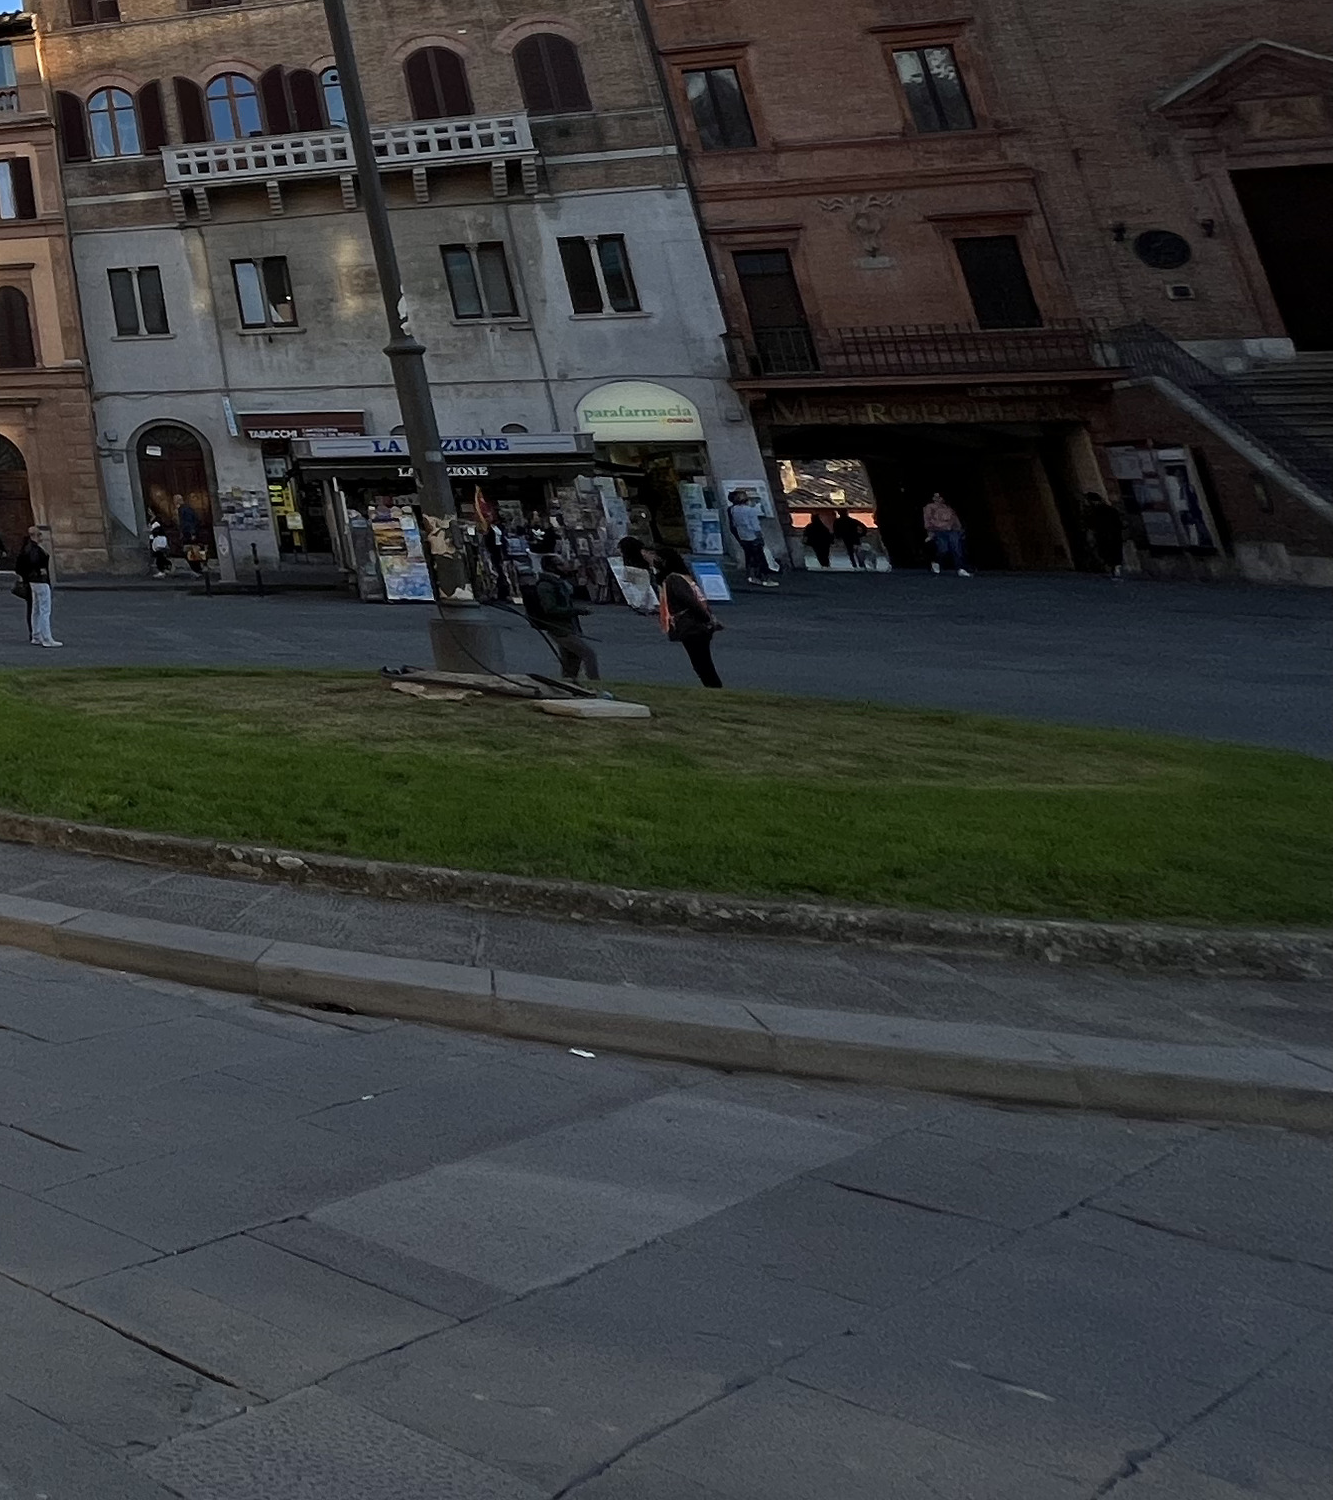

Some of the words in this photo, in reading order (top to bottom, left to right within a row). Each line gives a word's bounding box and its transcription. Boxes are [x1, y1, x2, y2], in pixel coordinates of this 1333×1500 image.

[583, 405, 693, 423] parafarmacia
[247, 430, 298, 439] TABACCHI
[372, 440, 402, 453] LA
[440, 438, 509, 452] ZIONE
[446, 466, 489, 476] ZIONE
